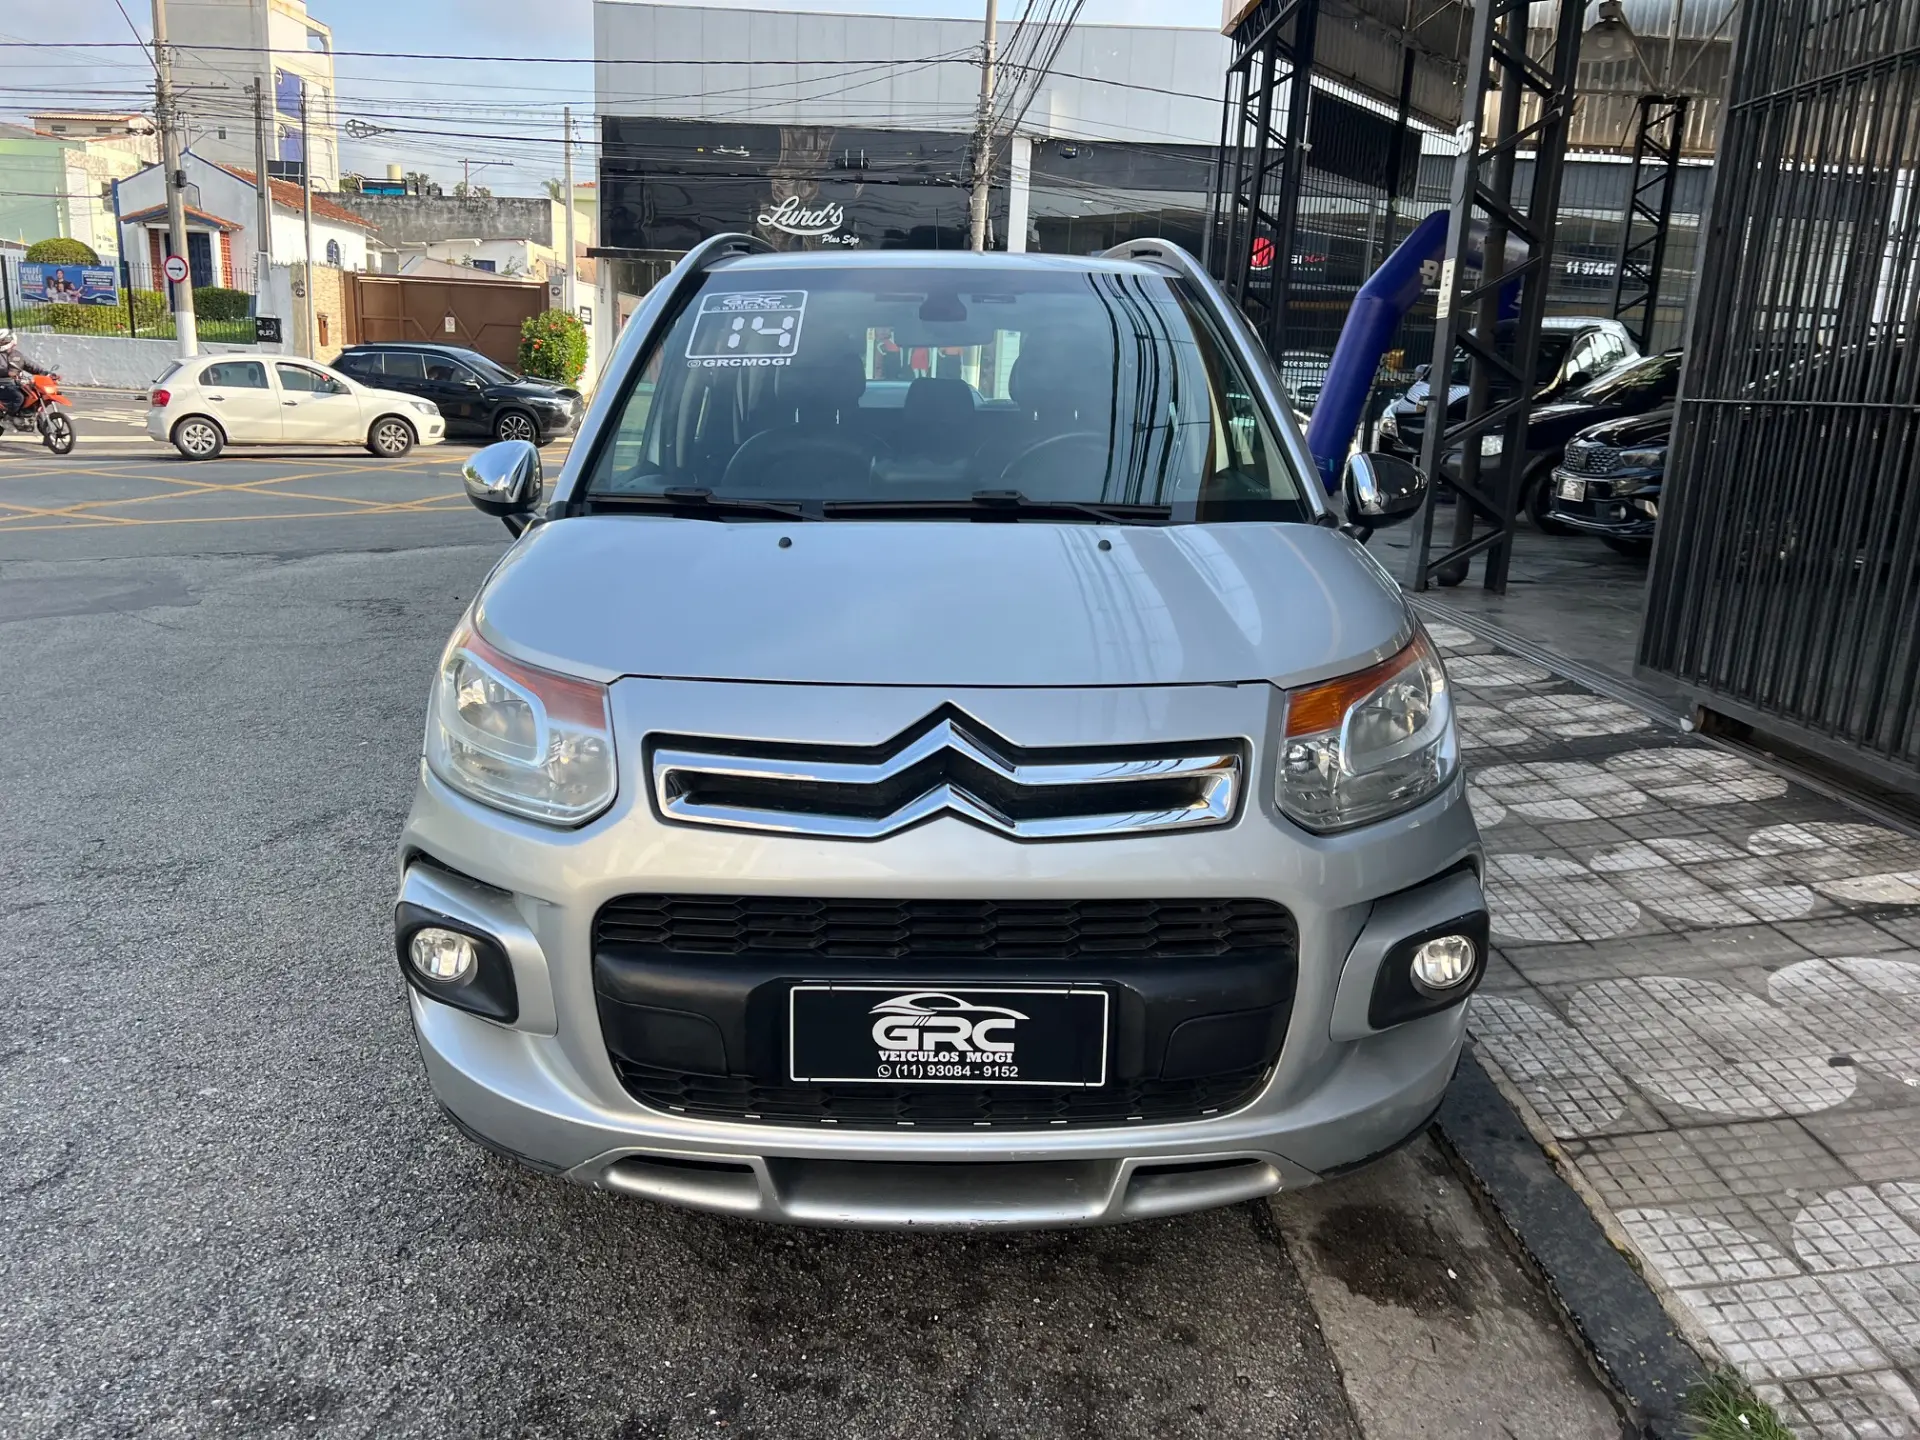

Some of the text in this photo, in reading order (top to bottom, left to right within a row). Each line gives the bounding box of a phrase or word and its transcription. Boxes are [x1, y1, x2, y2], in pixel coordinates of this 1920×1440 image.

[727, 316, 796, 350] 14
[872, 1015, 1016, 1052] GRC
[878, 1050, 1013, 1063] VEICULOS MOGI
[895, 1064, 924, 1078] (11)
[927, 1064, 971, 1077] 93084
[983, 1065, 1019, 1078] 9152
